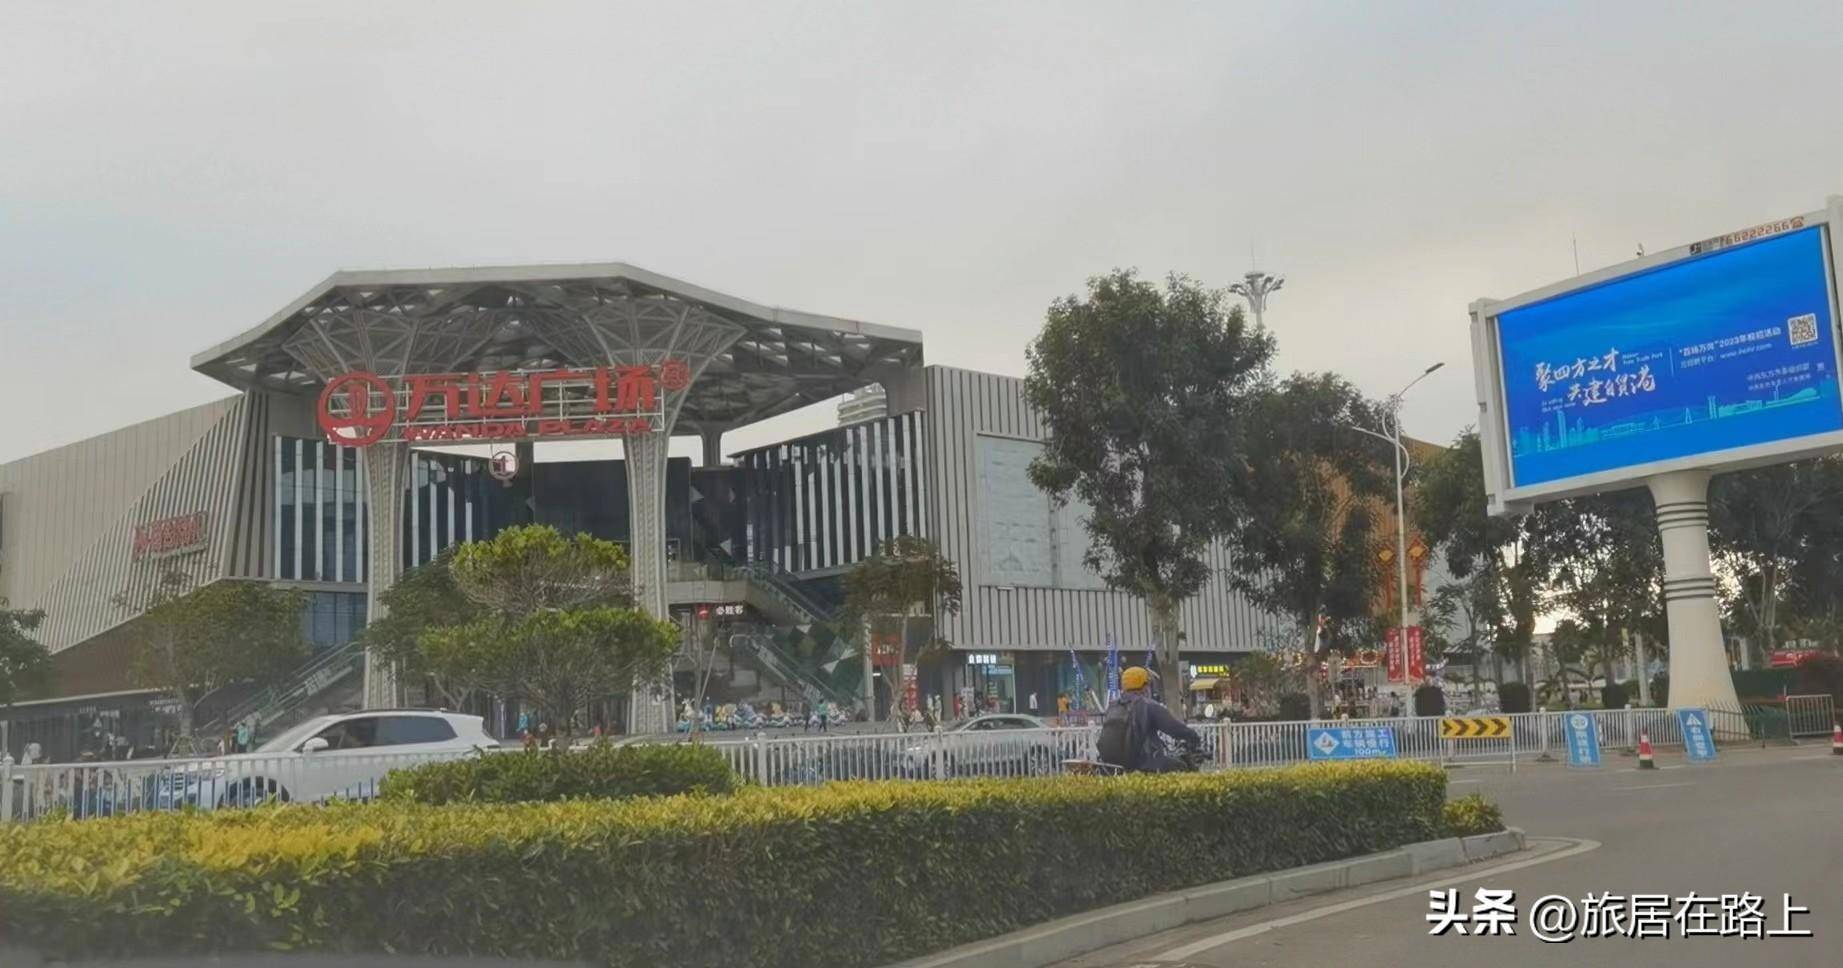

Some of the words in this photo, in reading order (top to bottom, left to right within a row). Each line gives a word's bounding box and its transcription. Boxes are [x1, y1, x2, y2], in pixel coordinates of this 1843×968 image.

[1536, 347, 1619, 392] 聚四方之才
[404, 365, 658, 420] 万达广场
[403, 423, 526, 442] WANDA
[539, 418, 654, 435] PLAZA
